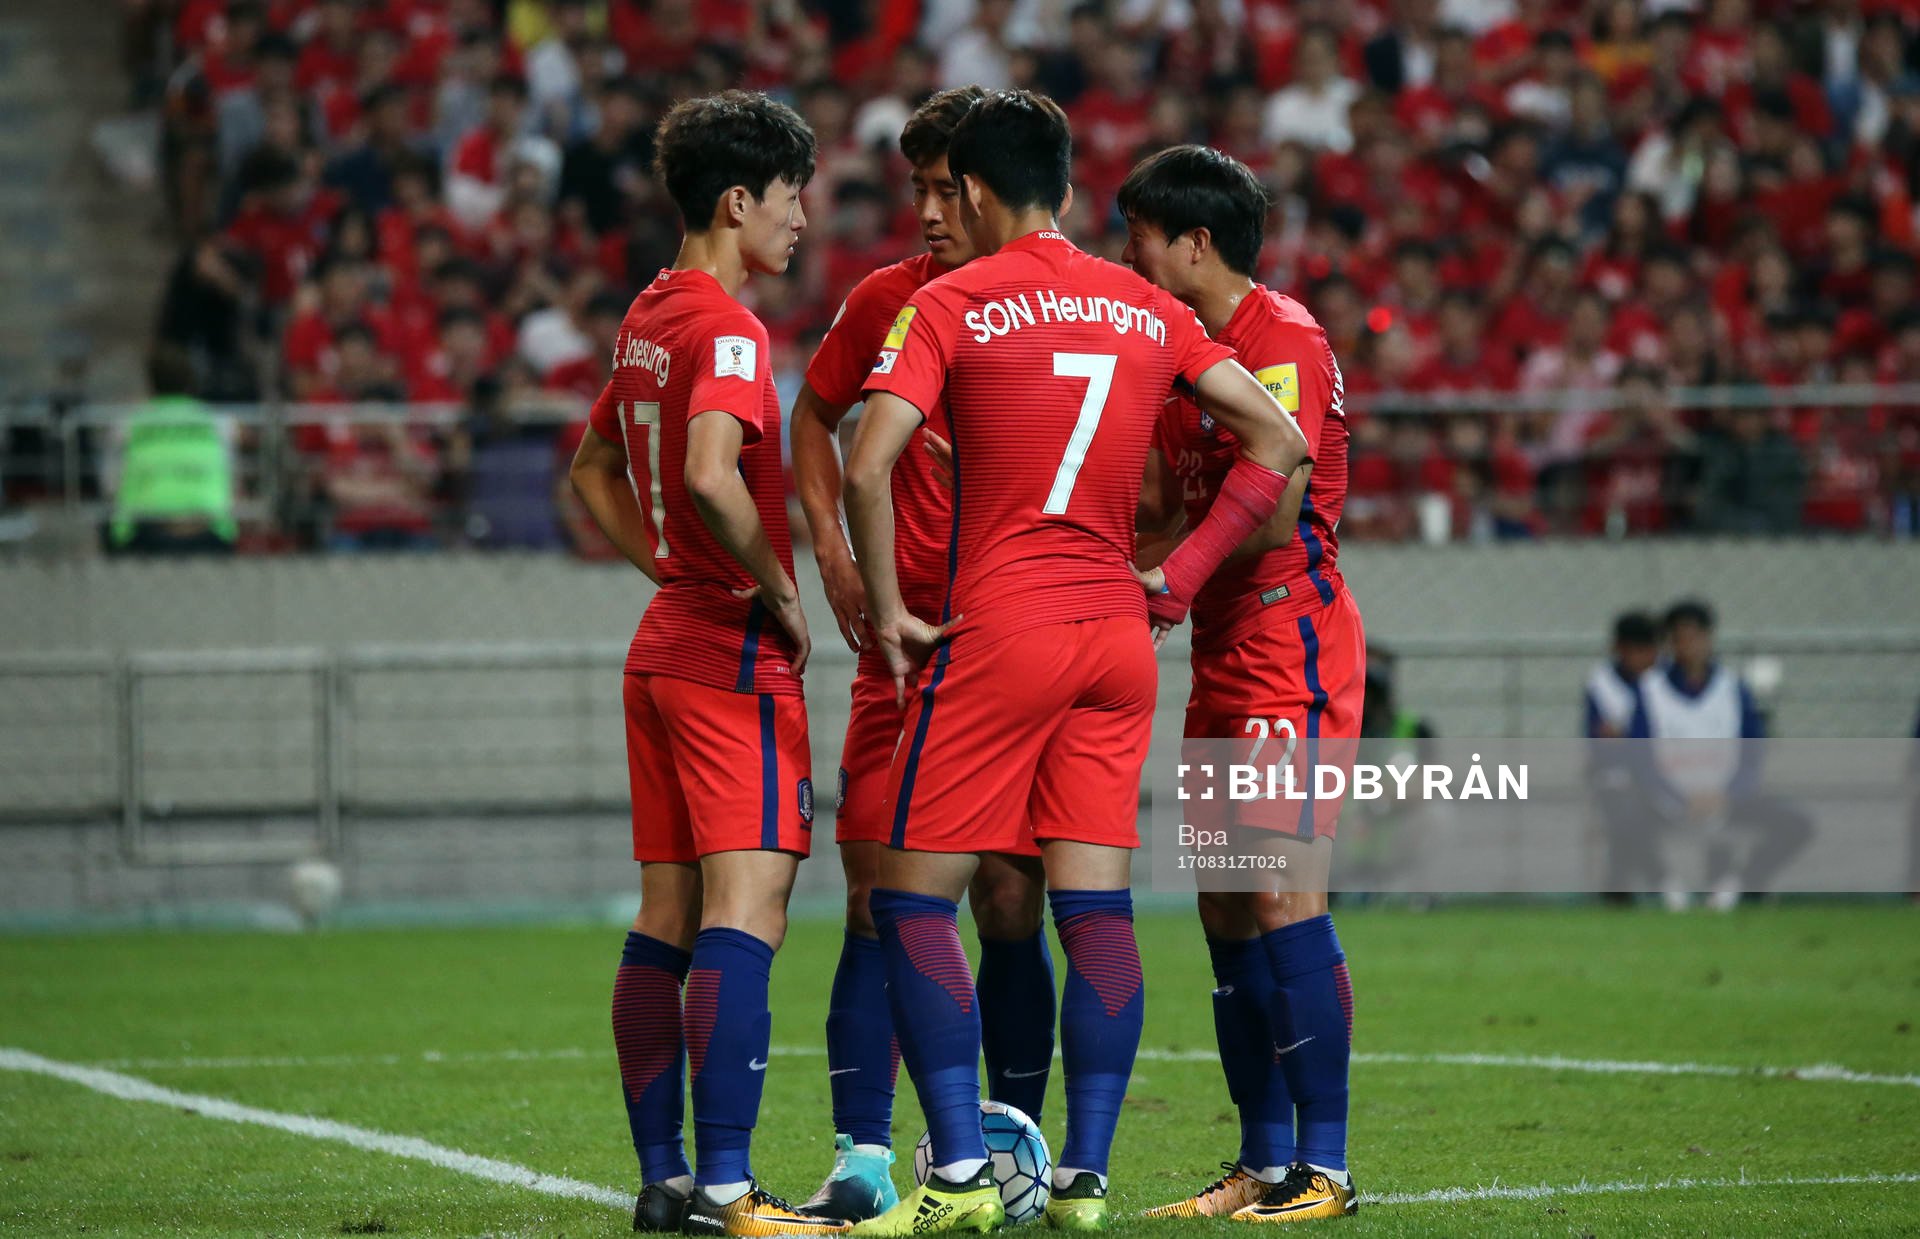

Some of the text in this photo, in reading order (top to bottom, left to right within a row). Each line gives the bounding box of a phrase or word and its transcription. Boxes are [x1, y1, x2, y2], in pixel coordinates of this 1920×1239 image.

[1038, 231, 1066, 241] KOREA
[965, 289, 1167, 348] SON Heungmin
[622, 331, 671, 389] Jaesung
[1042, 352, 1119, 515] 7
[1243, 717, 1298, 788] 22
[912, 1203, 954, 1236] adidas
